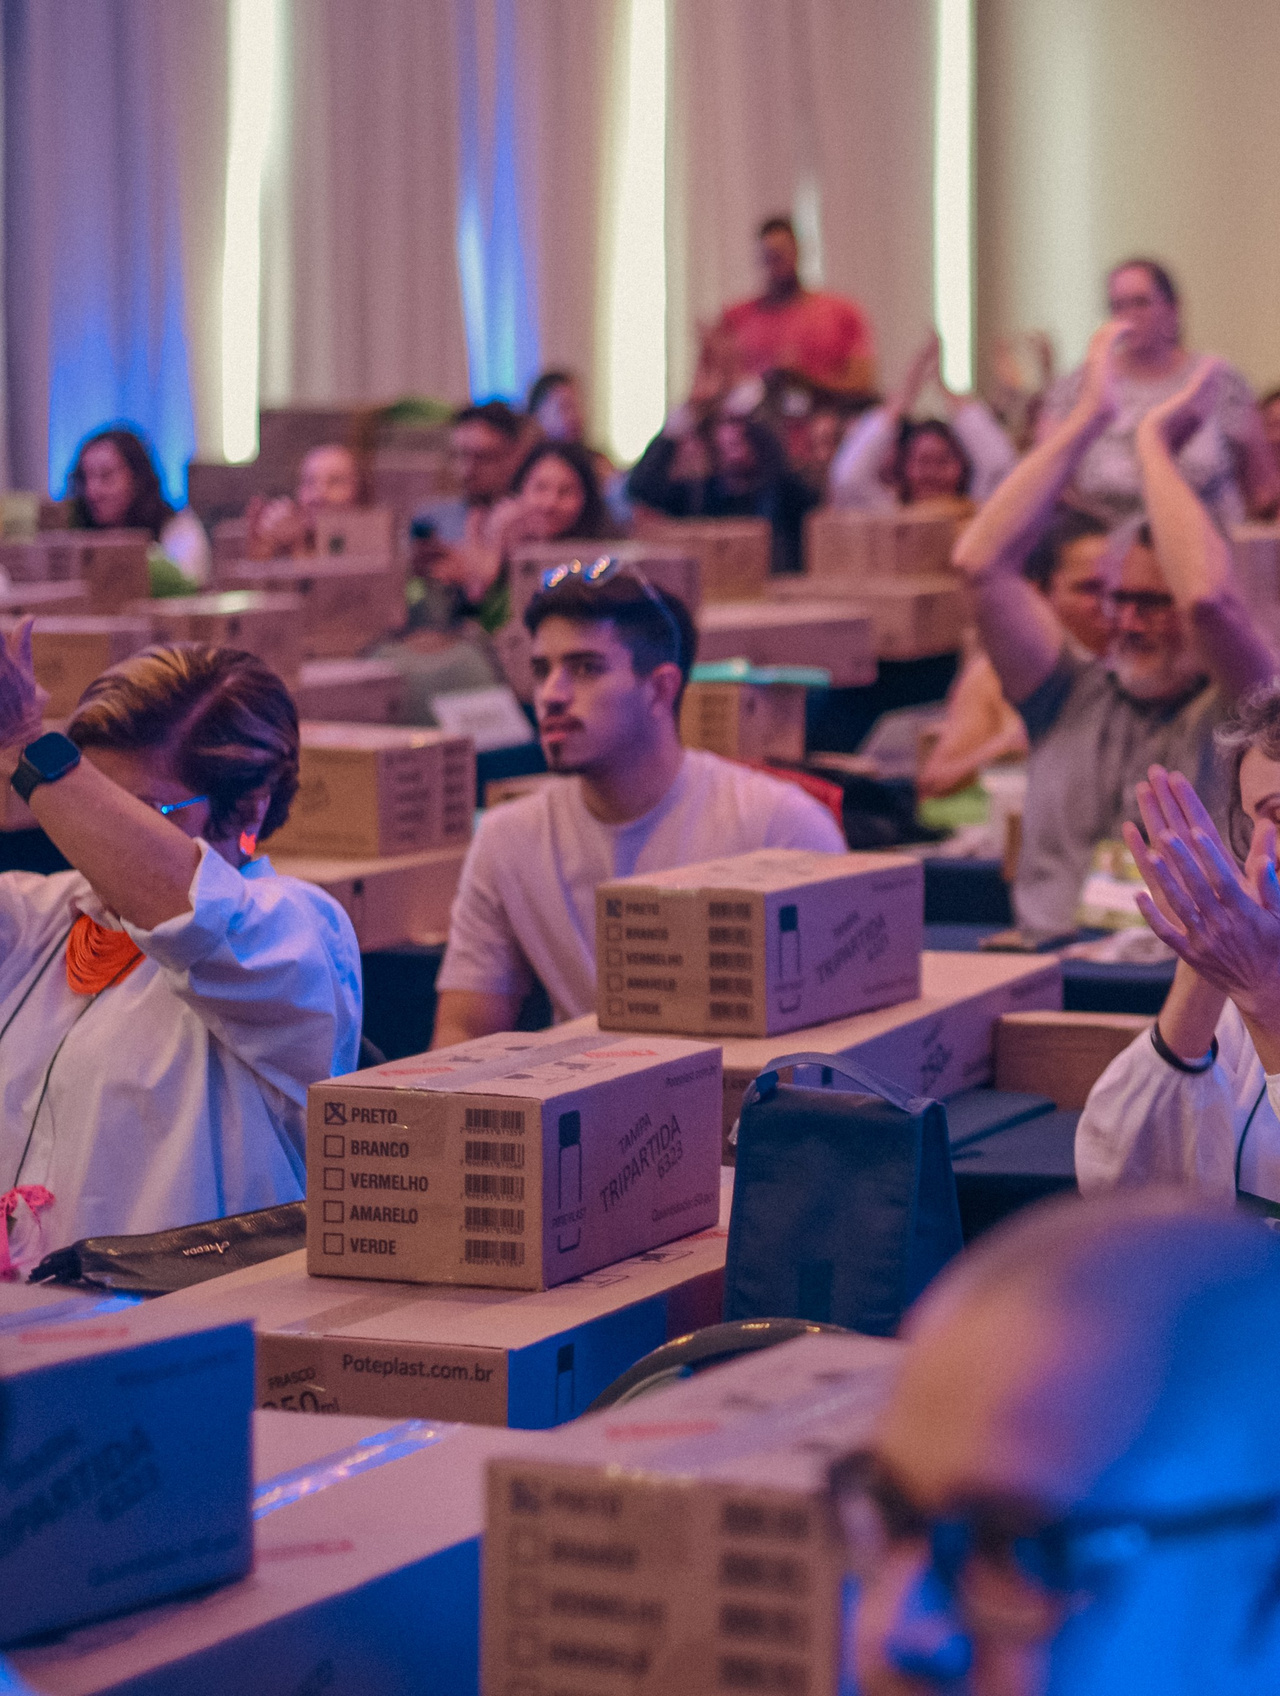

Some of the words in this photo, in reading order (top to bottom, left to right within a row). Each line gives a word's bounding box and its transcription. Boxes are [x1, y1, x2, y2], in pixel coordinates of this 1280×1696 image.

[351, 1107, 397, 1124] PRETO
[350, 1139, 409, 1158] BRANCO
[600, 1114, 681, 1212] TRIPARTIDA
[350, 1172, 429, 1192] VERMELHO
[350, 1204, 419, 1225] AMARELO
[350, 1237, 397, 1256] VERDE
[267, 1367, 316, 1390] FRASCO
[342, 1354, 494, 1383] Poteplast.com.br
